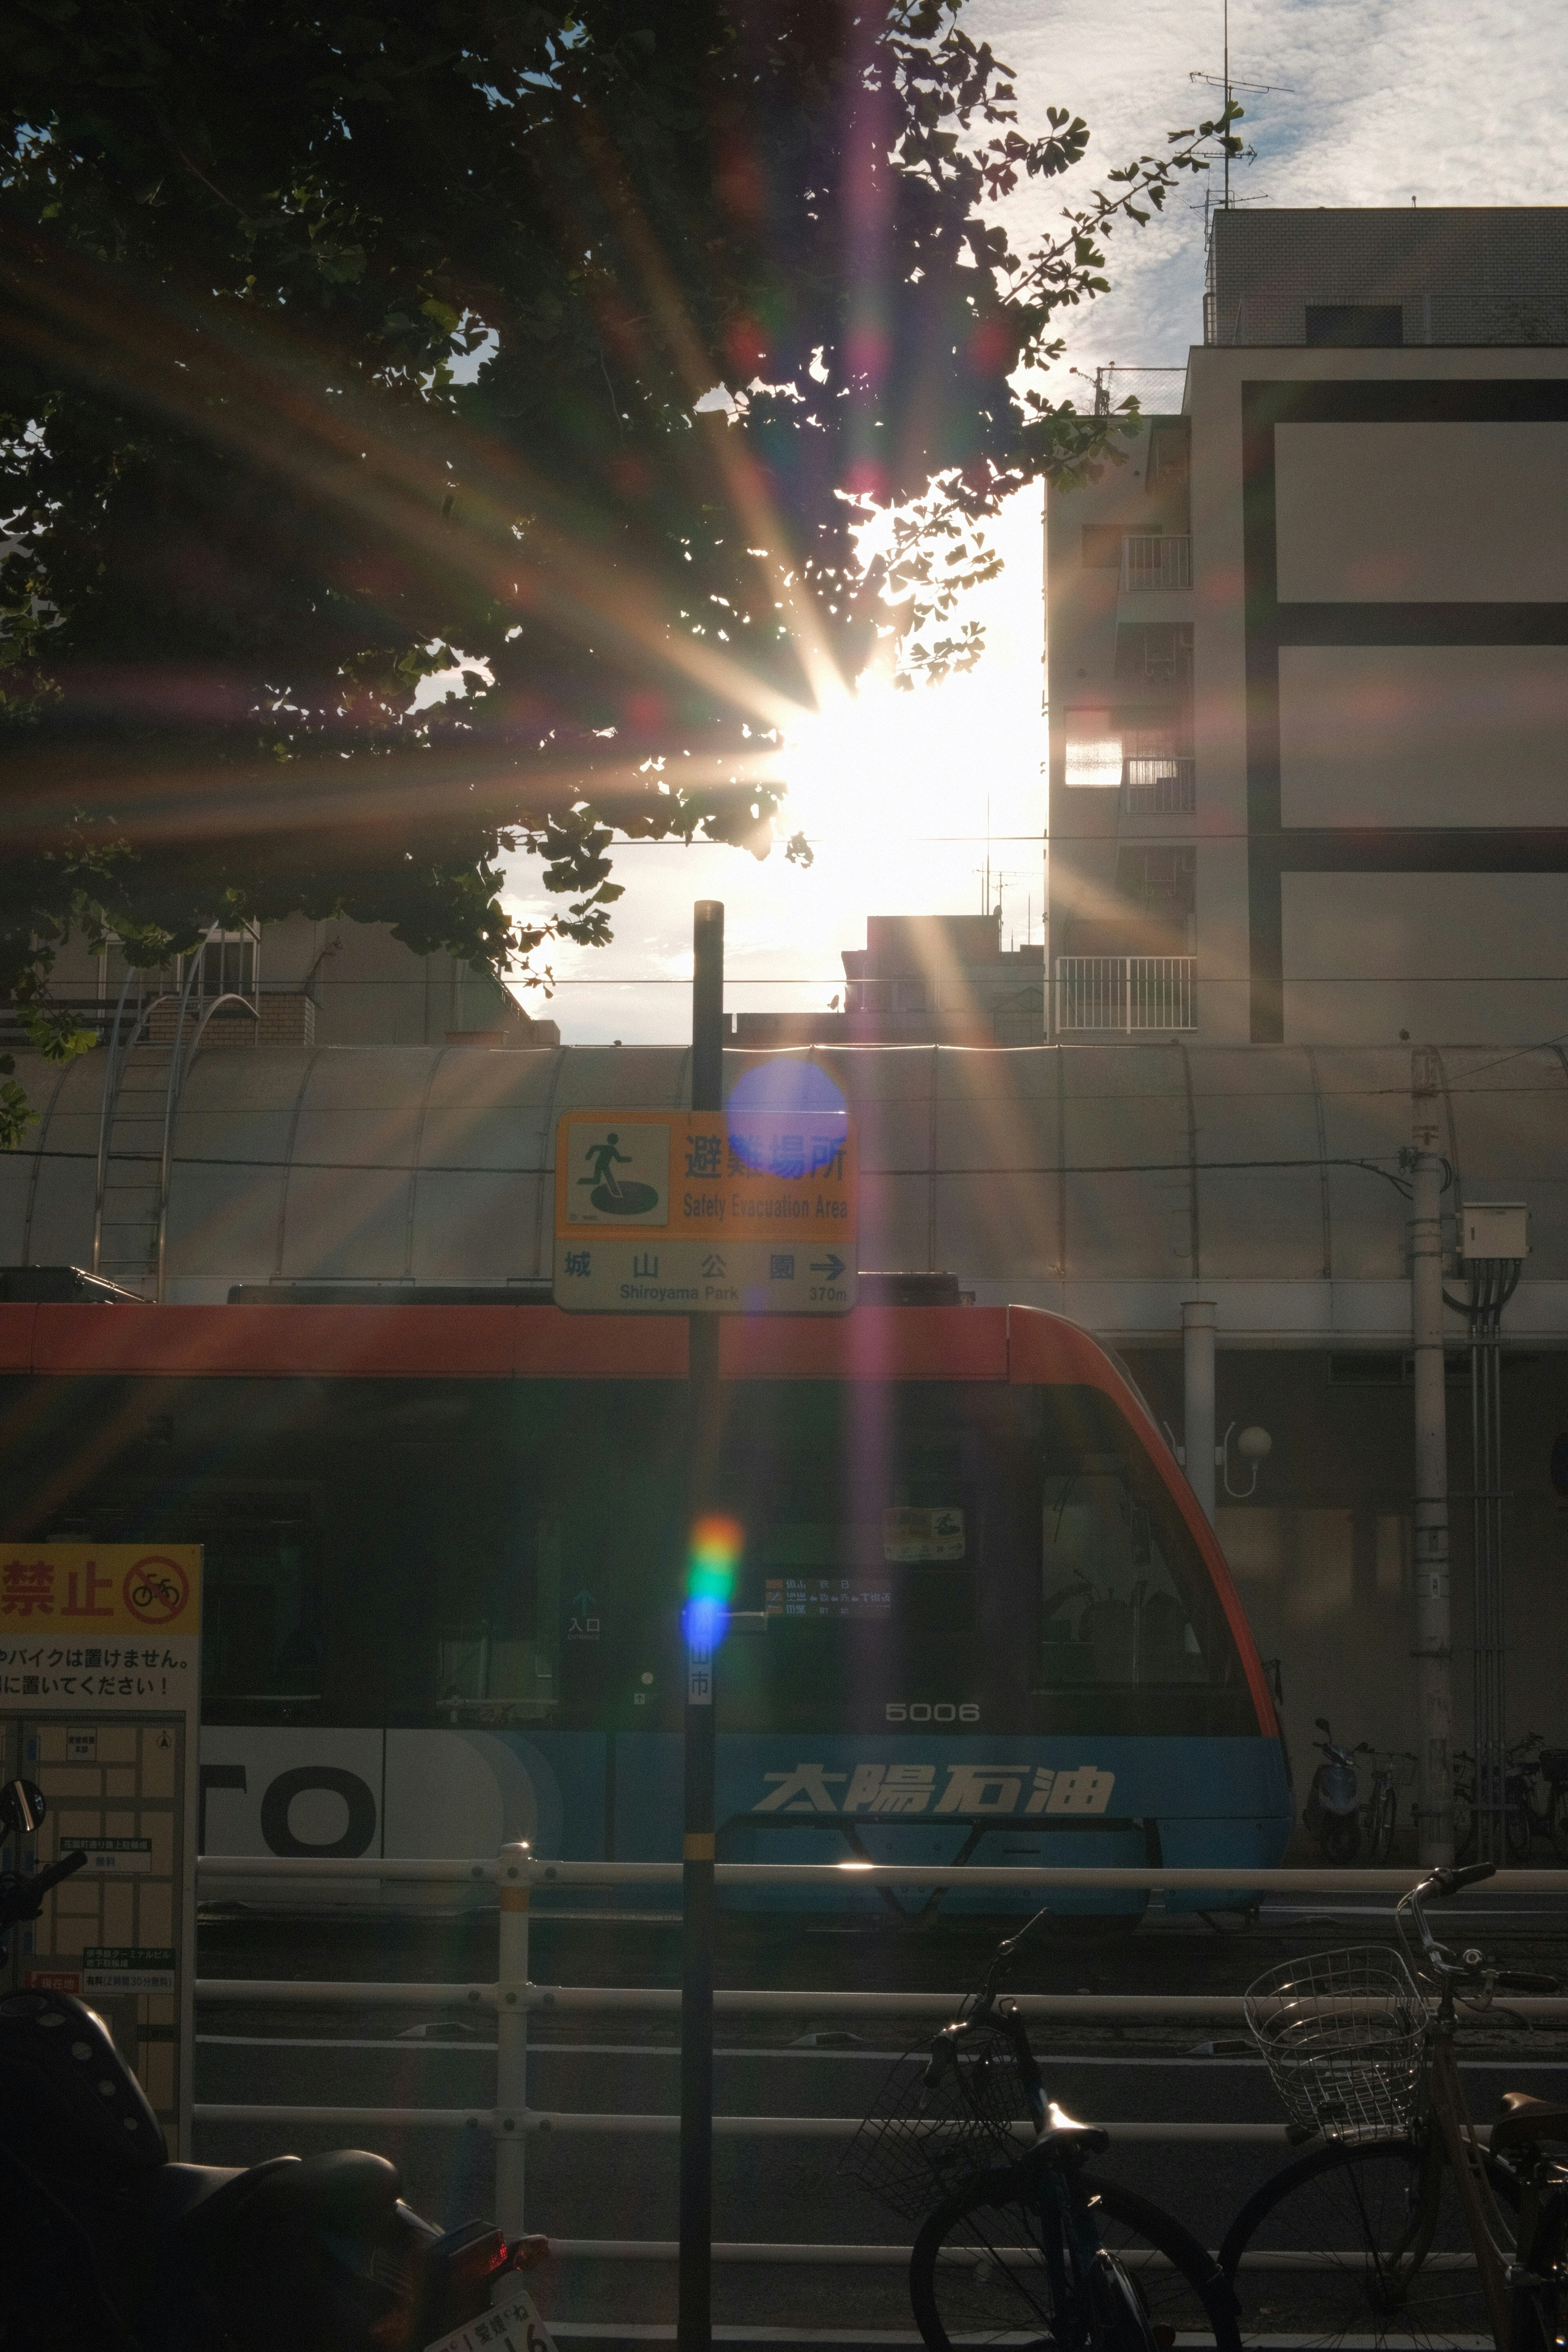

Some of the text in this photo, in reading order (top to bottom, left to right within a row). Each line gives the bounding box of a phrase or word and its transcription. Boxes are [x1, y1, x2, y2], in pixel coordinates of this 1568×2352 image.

[685, 1135, 846, 1180] 避難場所
[683, 1193, 848, 1221] Safety Evacuation Area
[565, 1251, 795, 1280] 城山公園
[620, 1285, 699, 1303] Shiroyama
[705, 1286, 738, 1301] Park
[2, 1560, 114, 1616] 禁止
[568, 1618, 600, 1632] 入口
[691, 1612, 708, 1696] 山市
[0, 1675, 167, 1695] に置いてください！
[885, 1703, 980, 1722] 5006
[751, 1763, 1115, 1814] 太陽石油
[475, 2314, 507, 2345] 愛媛
